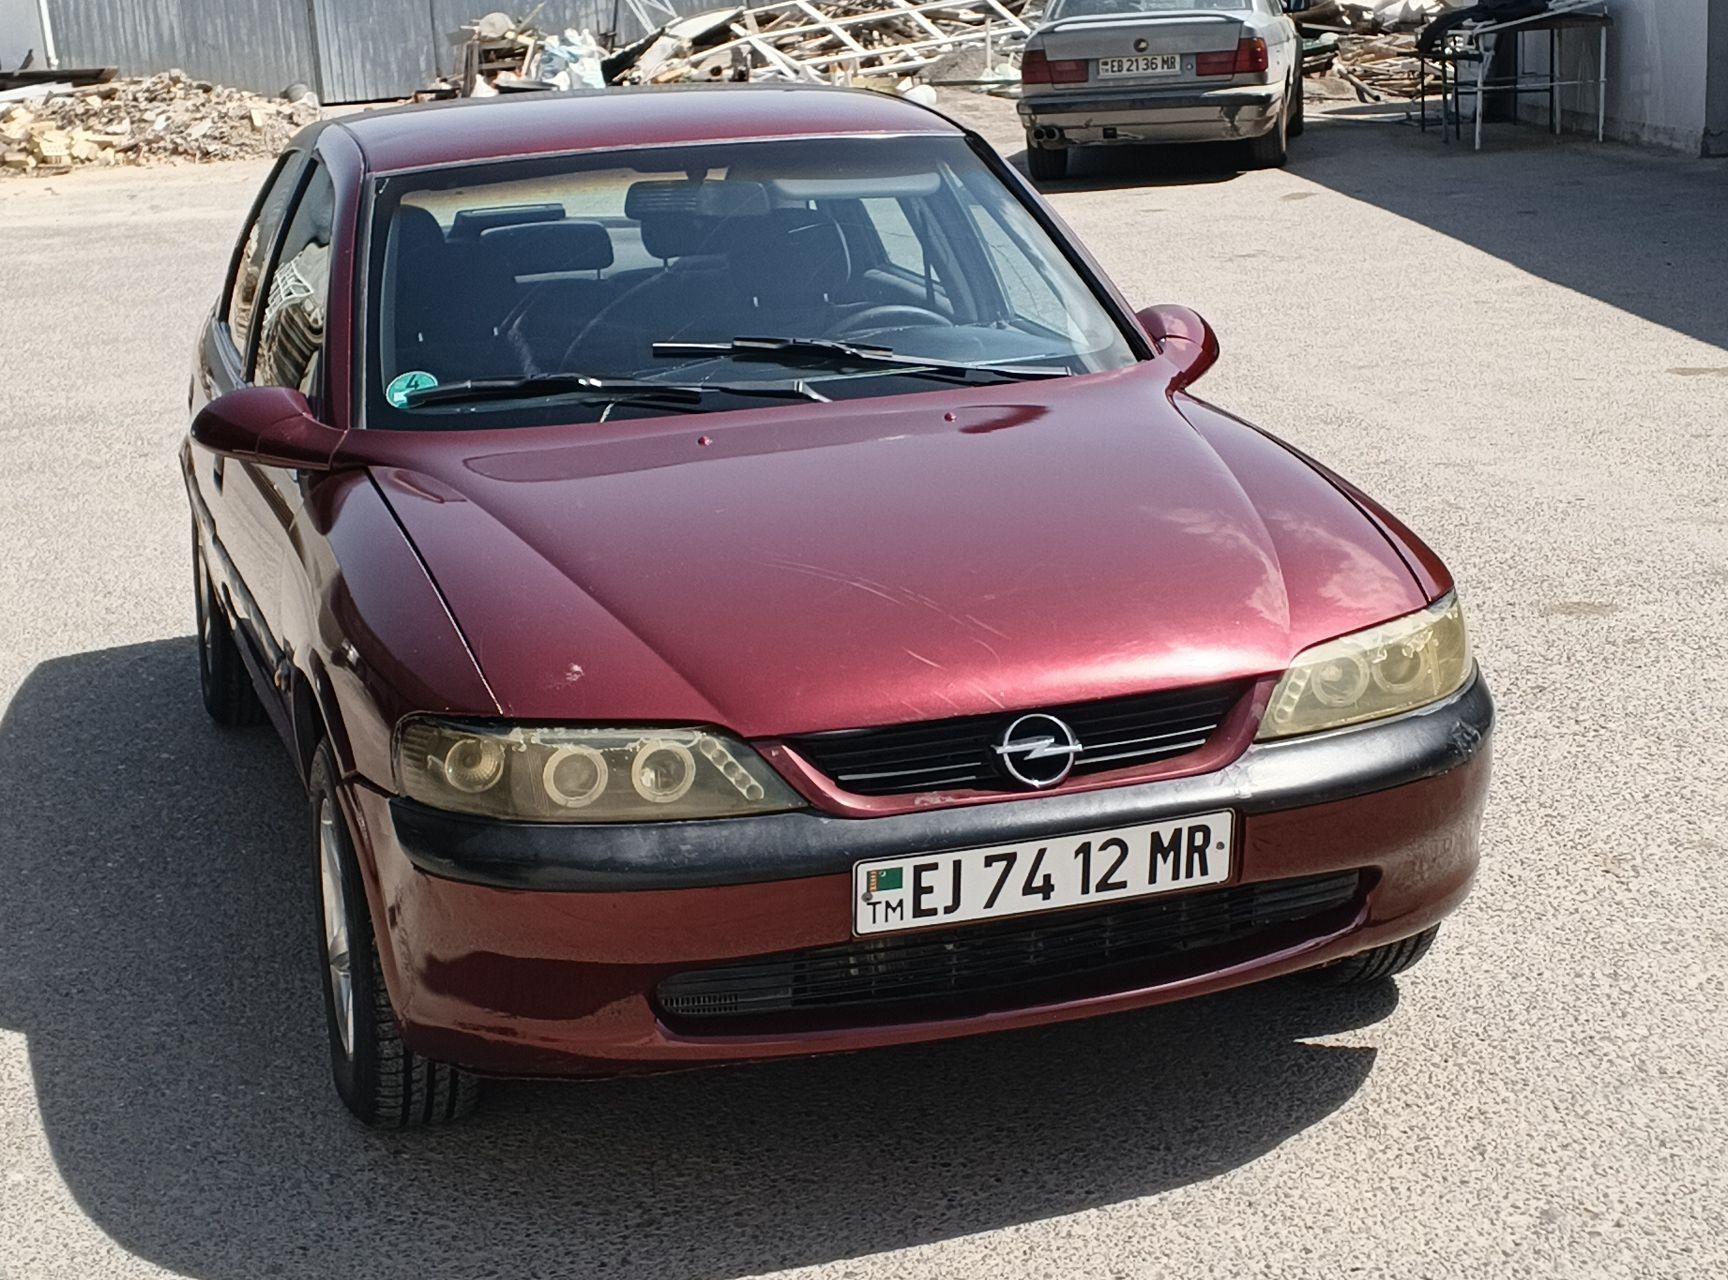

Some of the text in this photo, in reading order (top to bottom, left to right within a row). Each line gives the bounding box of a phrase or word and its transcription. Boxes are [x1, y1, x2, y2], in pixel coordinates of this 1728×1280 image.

[1110, 59, 1123, 73] EB
[1126, 58, 1139, 72] 21
[1142, 57, 1158, 71] 36
[1161, 56, 1176, 70] MR
[405, 374, 420, 390] 4
[912, 824, 1212, 919] EJ 74 12 MR
[866, 898, 904, 925] TM
